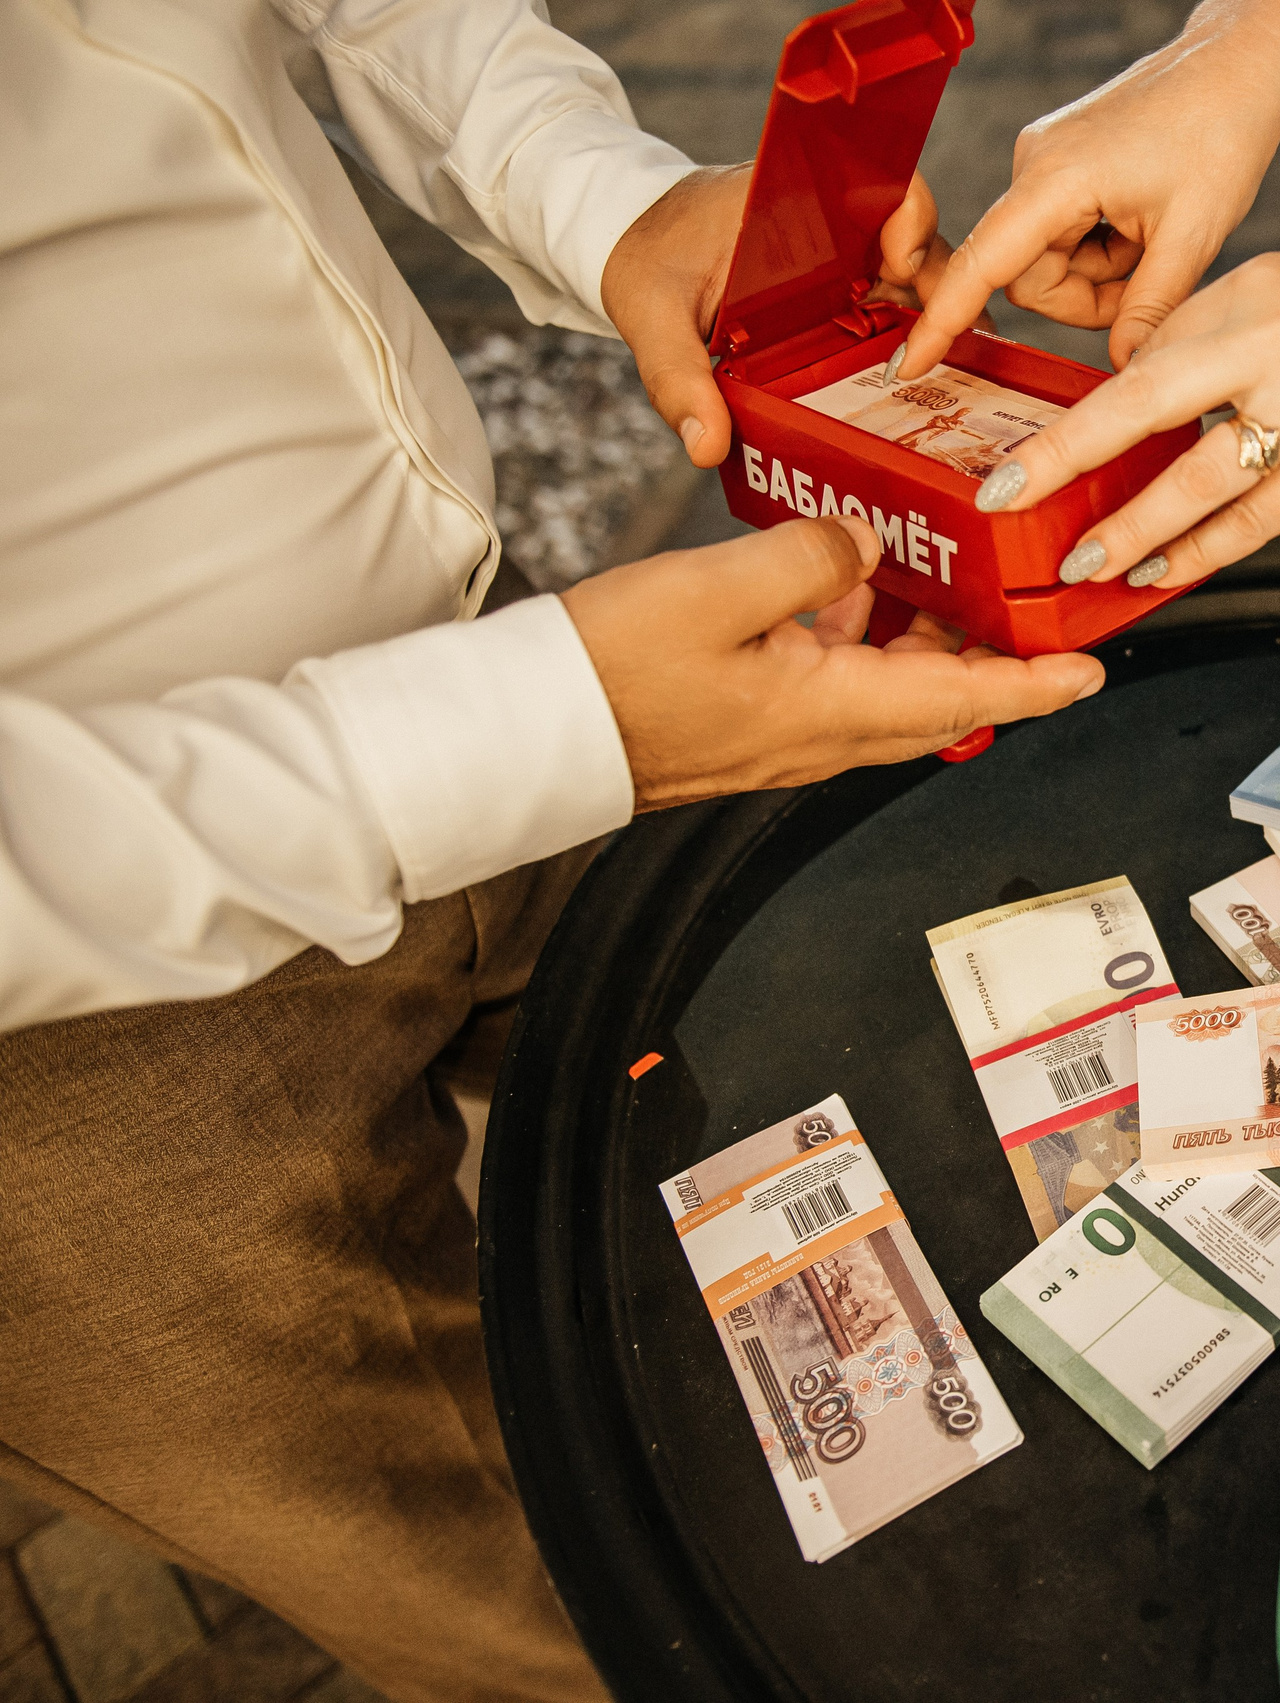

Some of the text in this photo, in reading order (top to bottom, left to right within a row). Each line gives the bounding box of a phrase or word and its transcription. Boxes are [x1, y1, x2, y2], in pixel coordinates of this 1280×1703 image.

[891, 384, 960, 411] 5000
[974, 915, 1003, 930] TENDER
[1090, 902, 1113, 937] EVRO
[1232, 908, 1268, 936] 100
[1175, 1009, 1239, 1033] 5000
[1171, 1127, 1233, 1150] ПЯТЬ
[1152, 1328, 1231, 1400] SB6005037514
[790, 1357, 867, 1465] 500
[932, 1376, 976, 1431] 500
